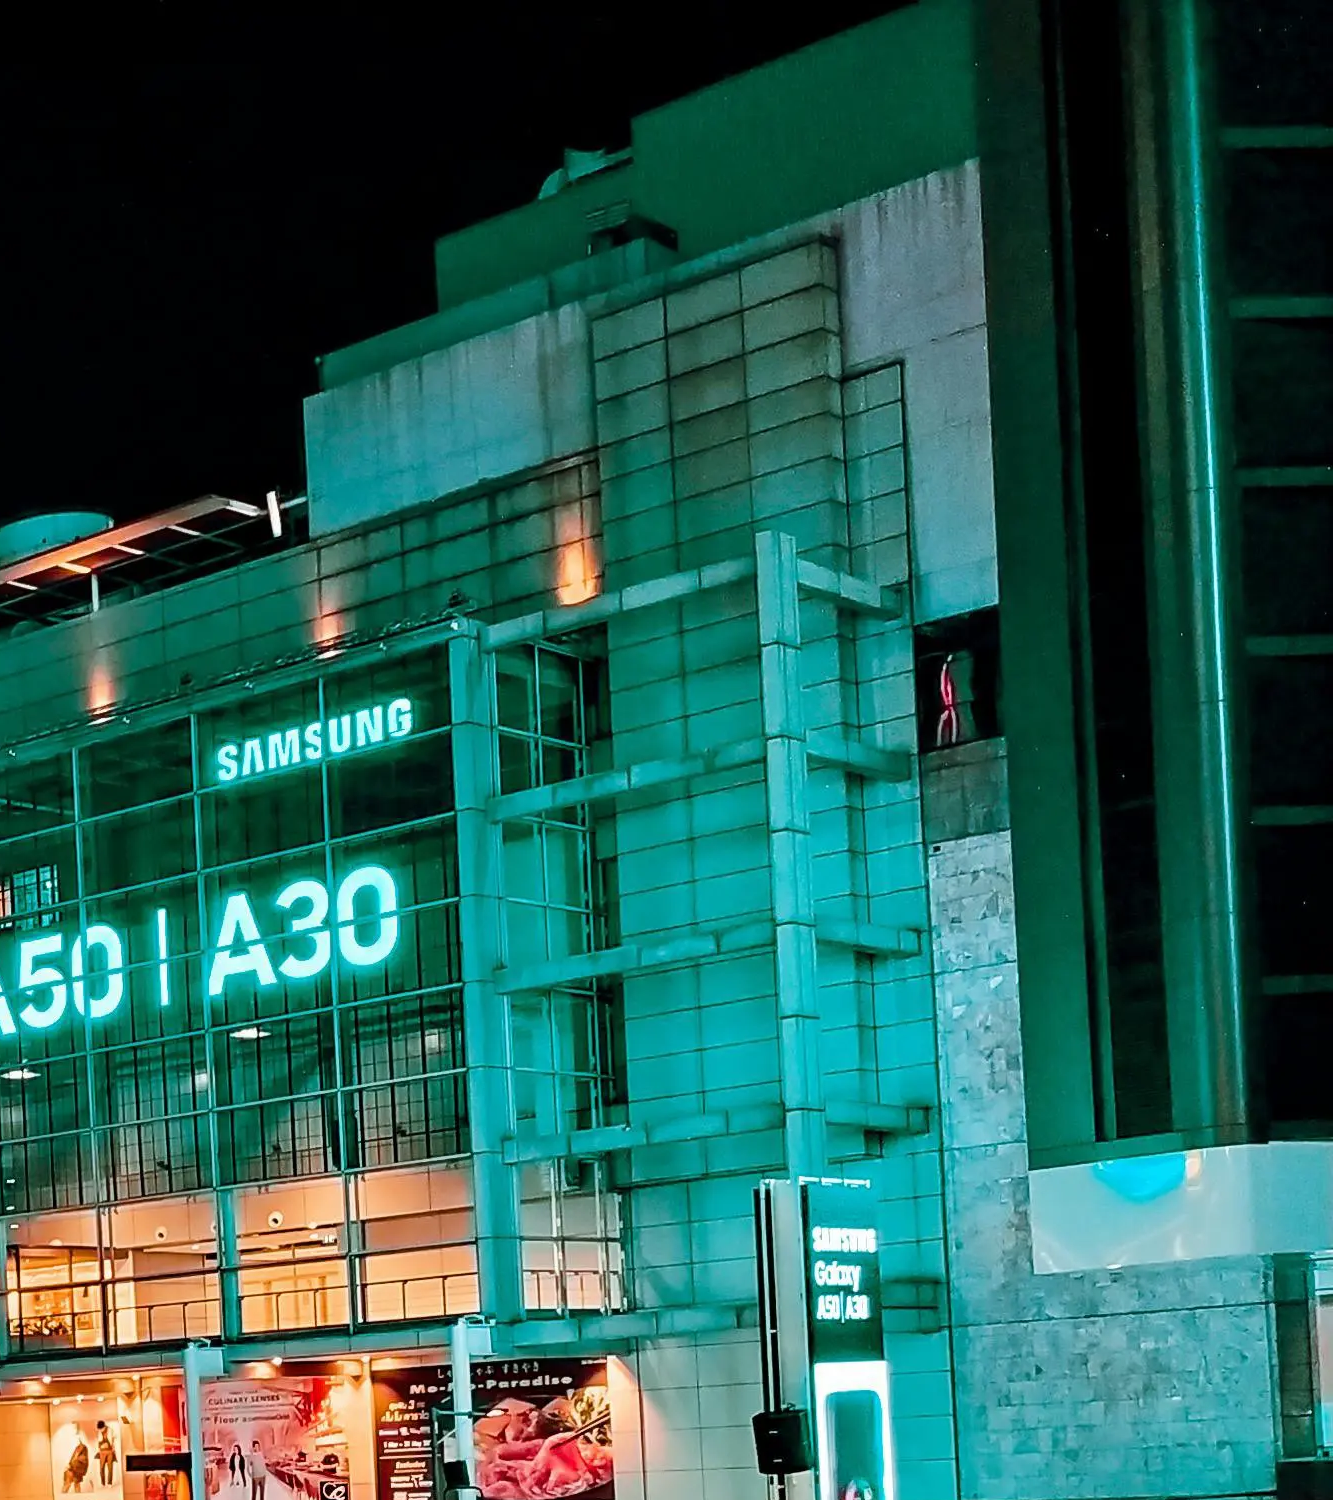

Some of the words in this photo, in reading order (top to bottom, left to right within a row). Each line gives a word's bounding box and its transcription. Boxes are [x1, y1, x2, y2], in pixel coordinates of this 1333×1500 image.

[216, 698, 414, 781] SAMSUNG
[208, 864, 401, 997] A30
[814, 1260, 862, 1292] Galaxy
